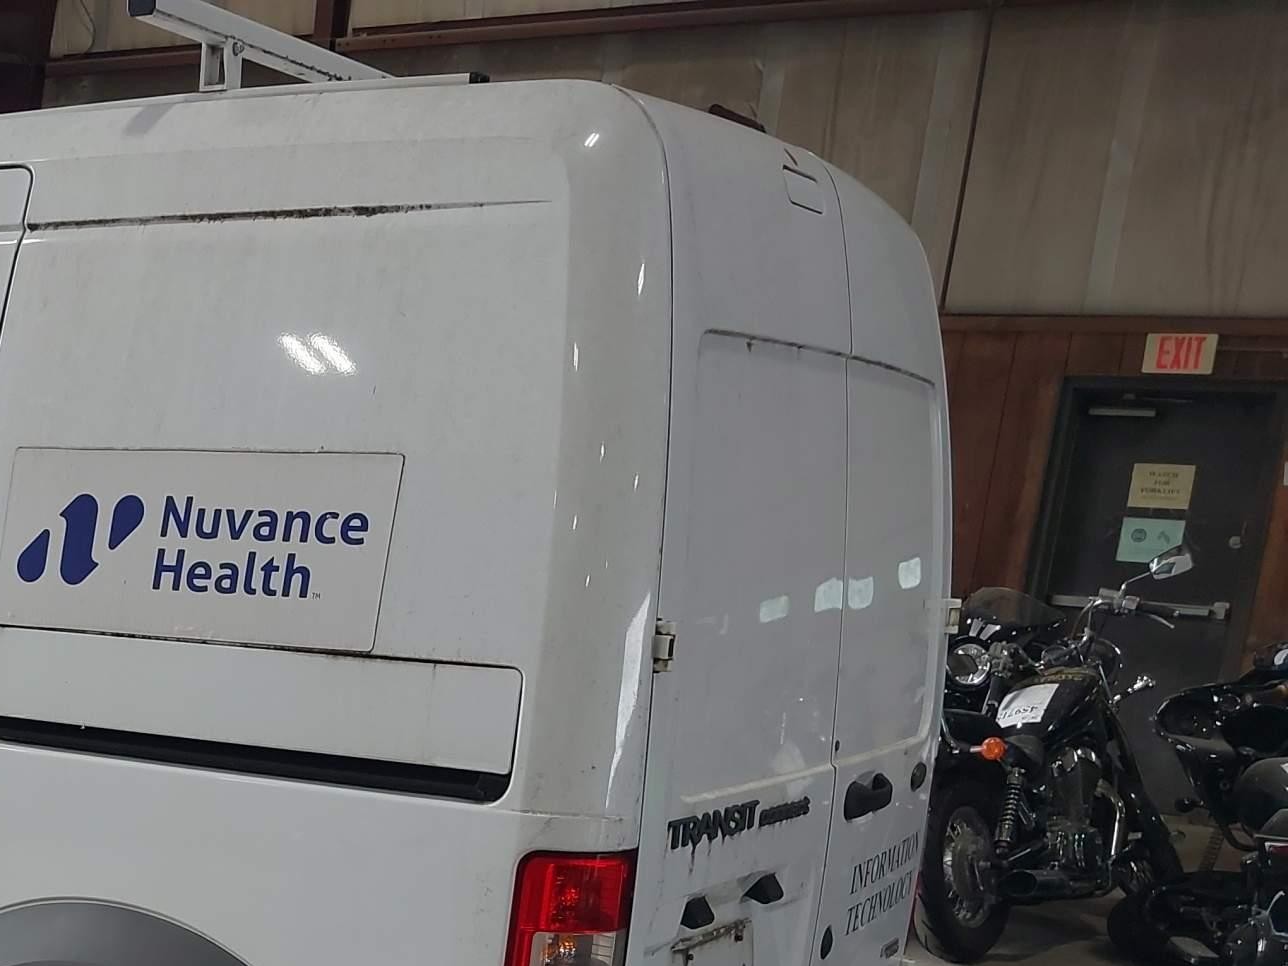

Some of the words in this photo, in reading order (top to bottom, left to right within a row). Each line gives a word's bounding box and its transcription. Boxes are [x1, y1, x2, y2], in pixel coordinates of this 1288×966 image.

[1156, 336, 1207, 370] EXIT
[160, 495, 369, 546] Nuvance
[152, 549, 311, 599] Health
[668, 799, 760, 849] TRANSIT
[849, 831, 920, 895] INFORMATION
[844, 870, 913, 936] TECHNOLOGY
